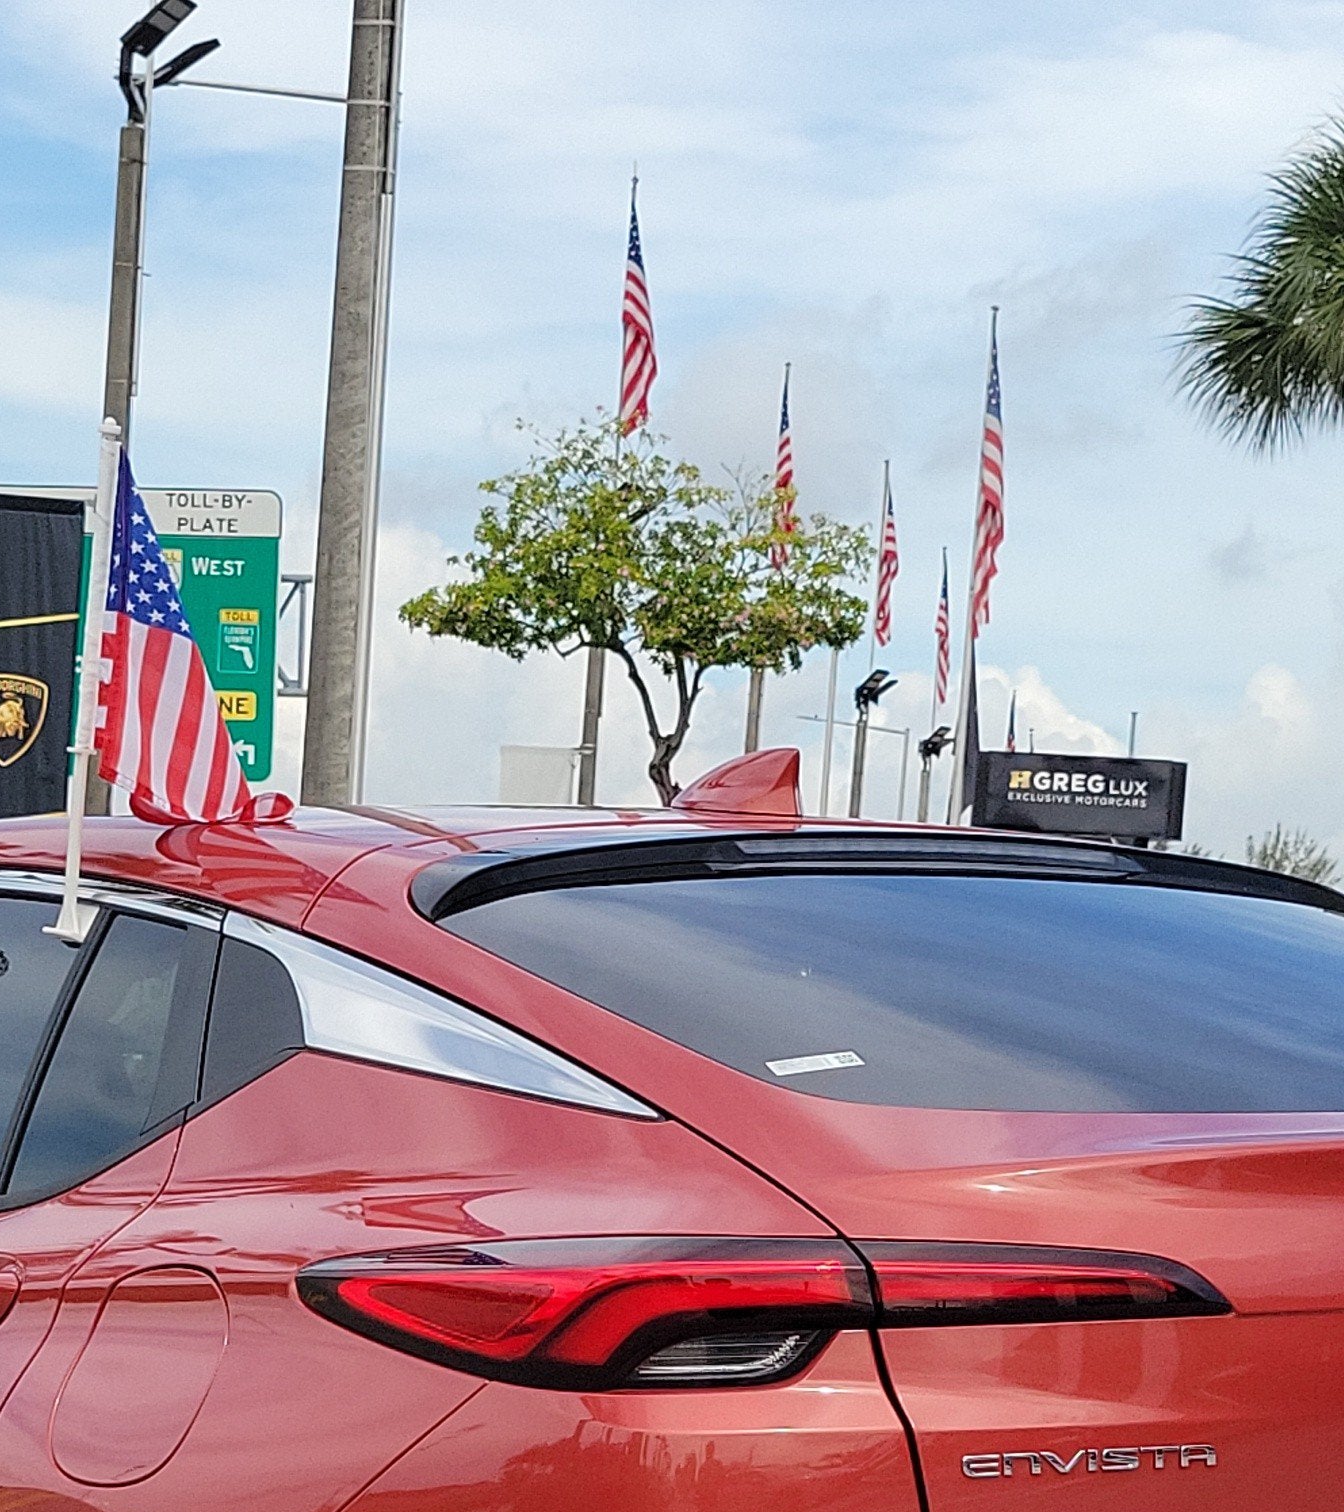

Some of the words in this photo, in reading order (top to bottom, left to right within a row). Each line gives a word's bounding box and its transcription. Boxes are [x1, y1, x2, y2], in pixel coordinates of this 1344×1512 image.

[165, 493, 252, 509] TOLL-BY-
[177, 517, 238, 533] PLATE
[191, 556, 246, 576] WEST
[225, 611, 253, 621] TOLL
[1108, 780, 1149, 797] LUX
[1007, 792, 1071, 805] EXCLUSIVE
[1074, 796, 1148, 809] MOTORCARS
[962, 1444, 1218, 1478] ENVISTA
